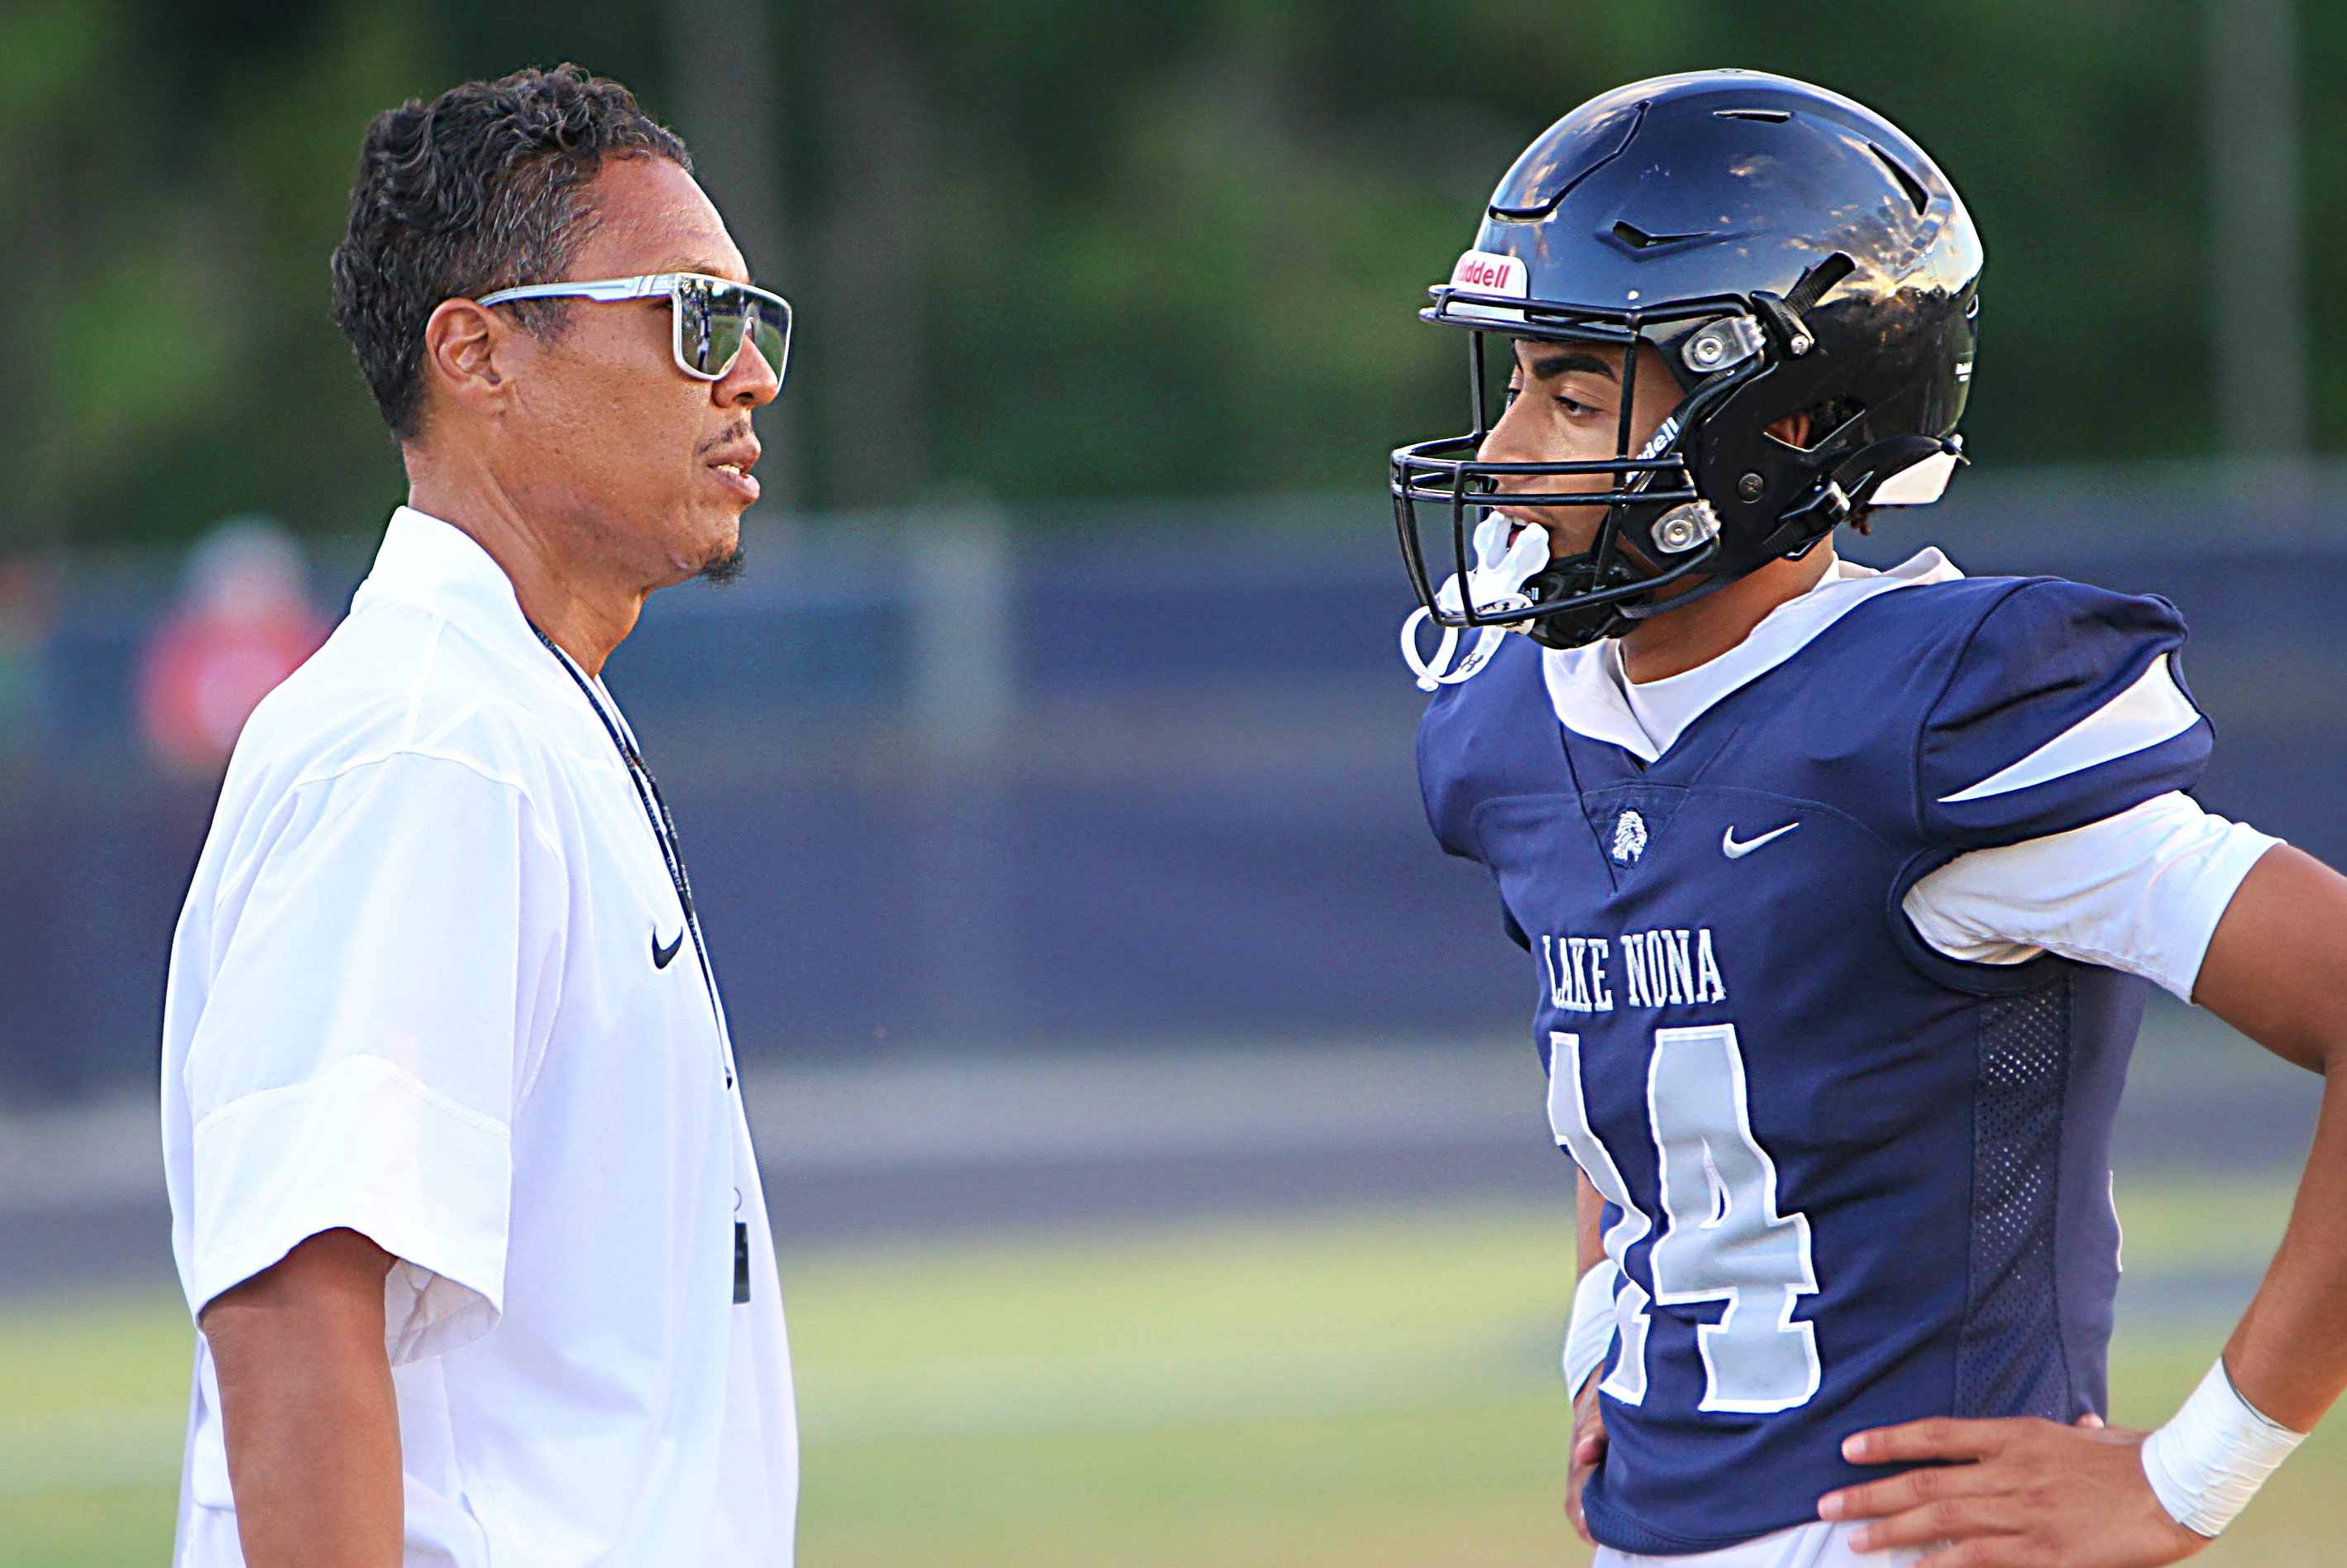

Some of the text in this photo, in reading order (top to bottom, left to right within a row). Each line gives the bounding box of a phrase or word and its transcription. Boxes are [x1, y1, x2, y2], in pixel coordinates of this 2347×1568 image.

[1542, 928, 1726, 1012] LAKE NONA
[1547, 1023, 1821, 1413] 14
